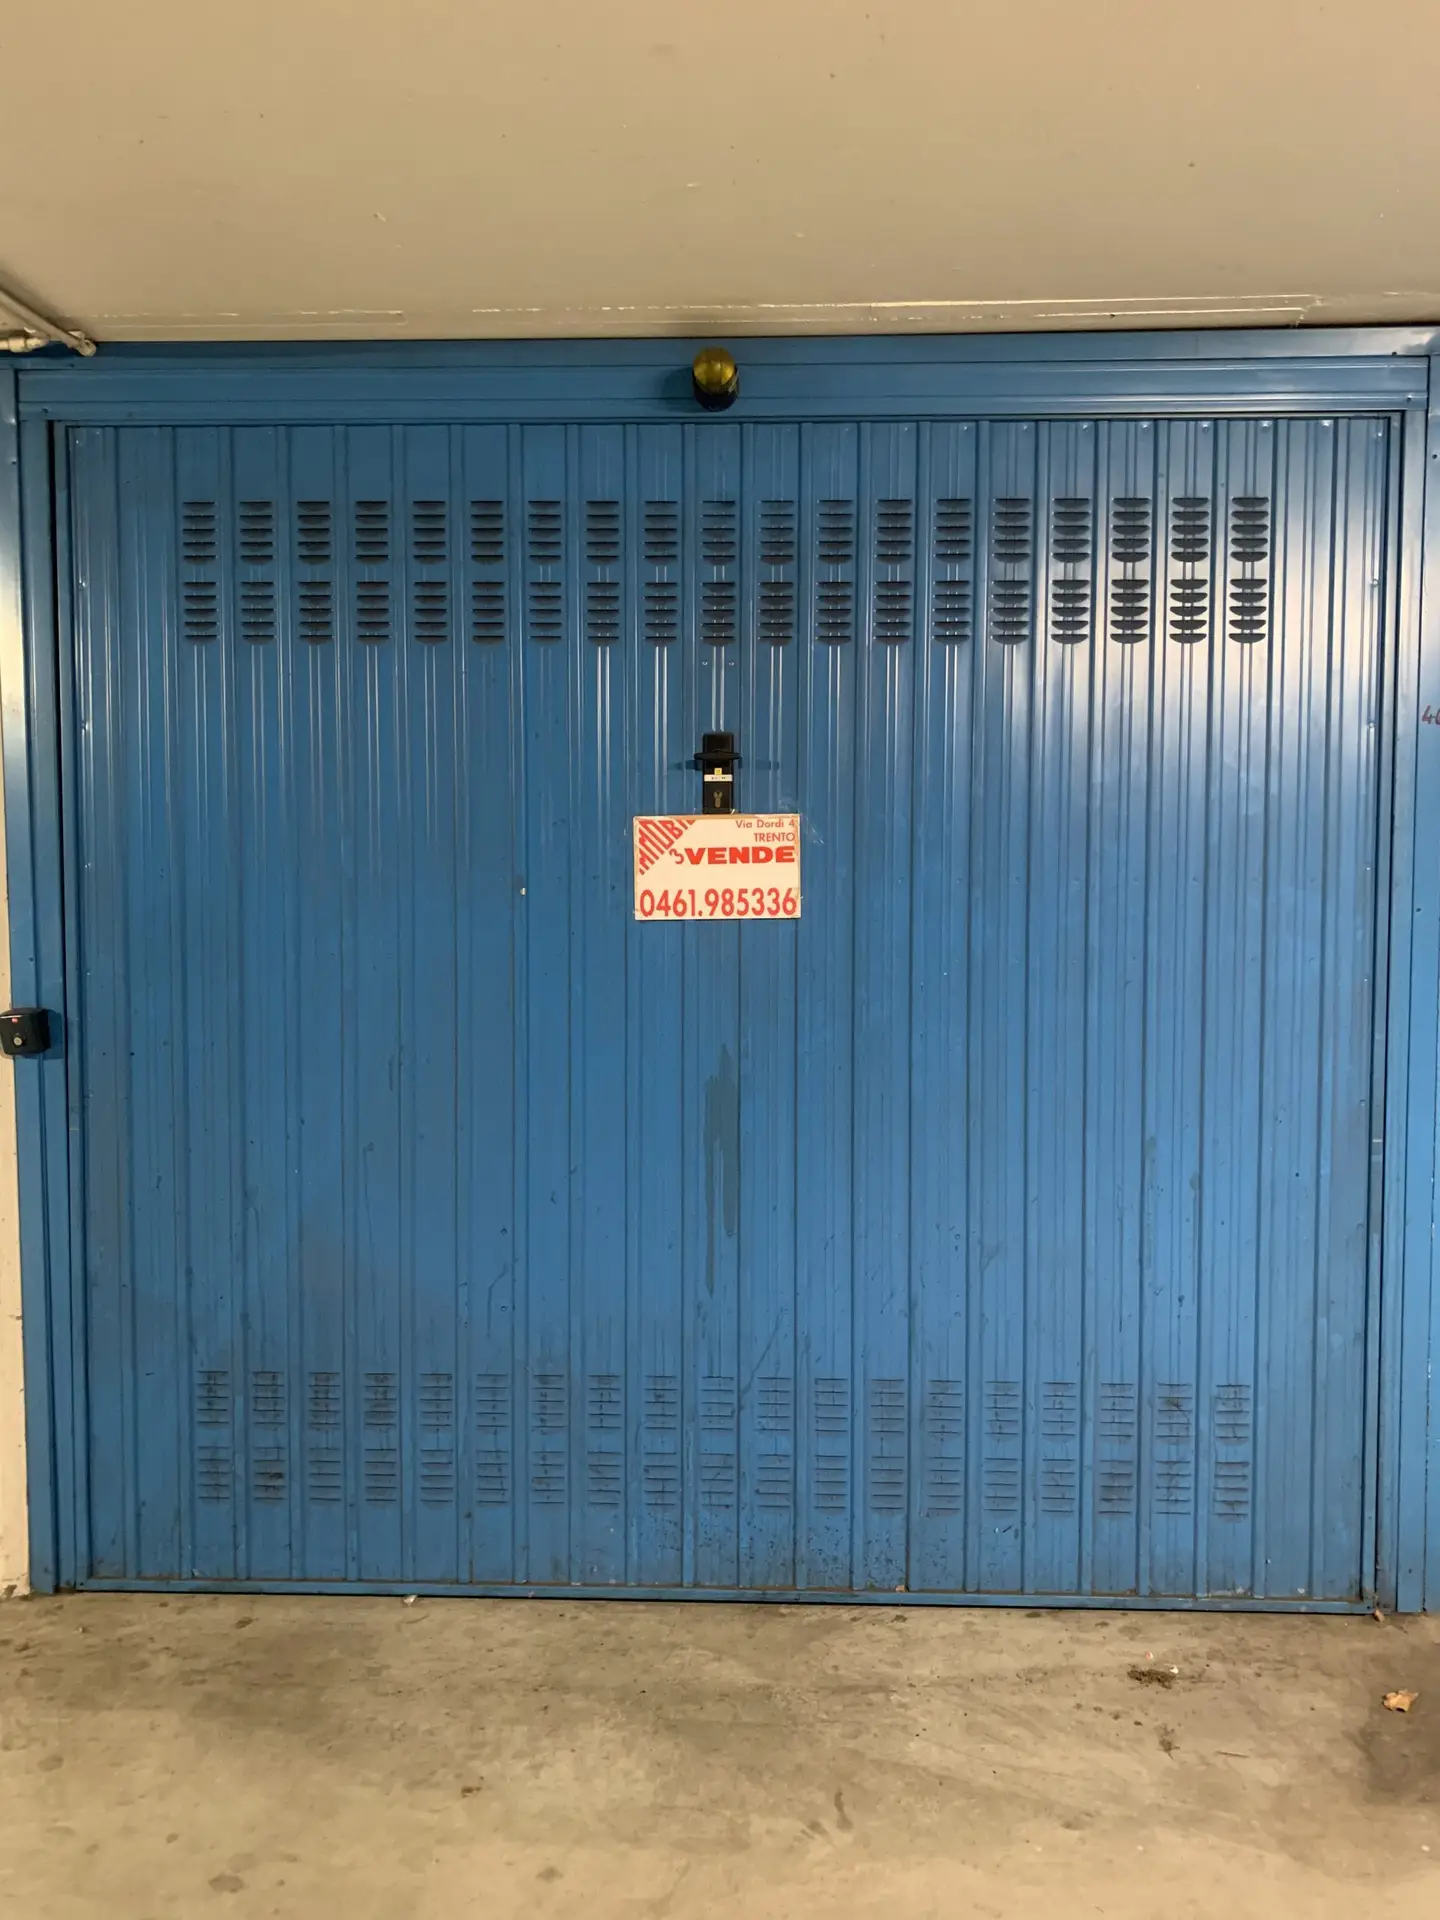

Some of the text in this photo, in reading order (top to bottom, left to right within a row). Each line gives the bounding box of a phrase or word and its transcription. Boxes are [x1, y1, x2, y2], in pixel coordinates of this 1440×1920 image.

[735, 818, 795, 829] Via Dordi 4
[754, 832, 796, 843] TRENTO
[684, 845, 795, 865] VENDE
[639, 887, 797, 918] 0461.985336
